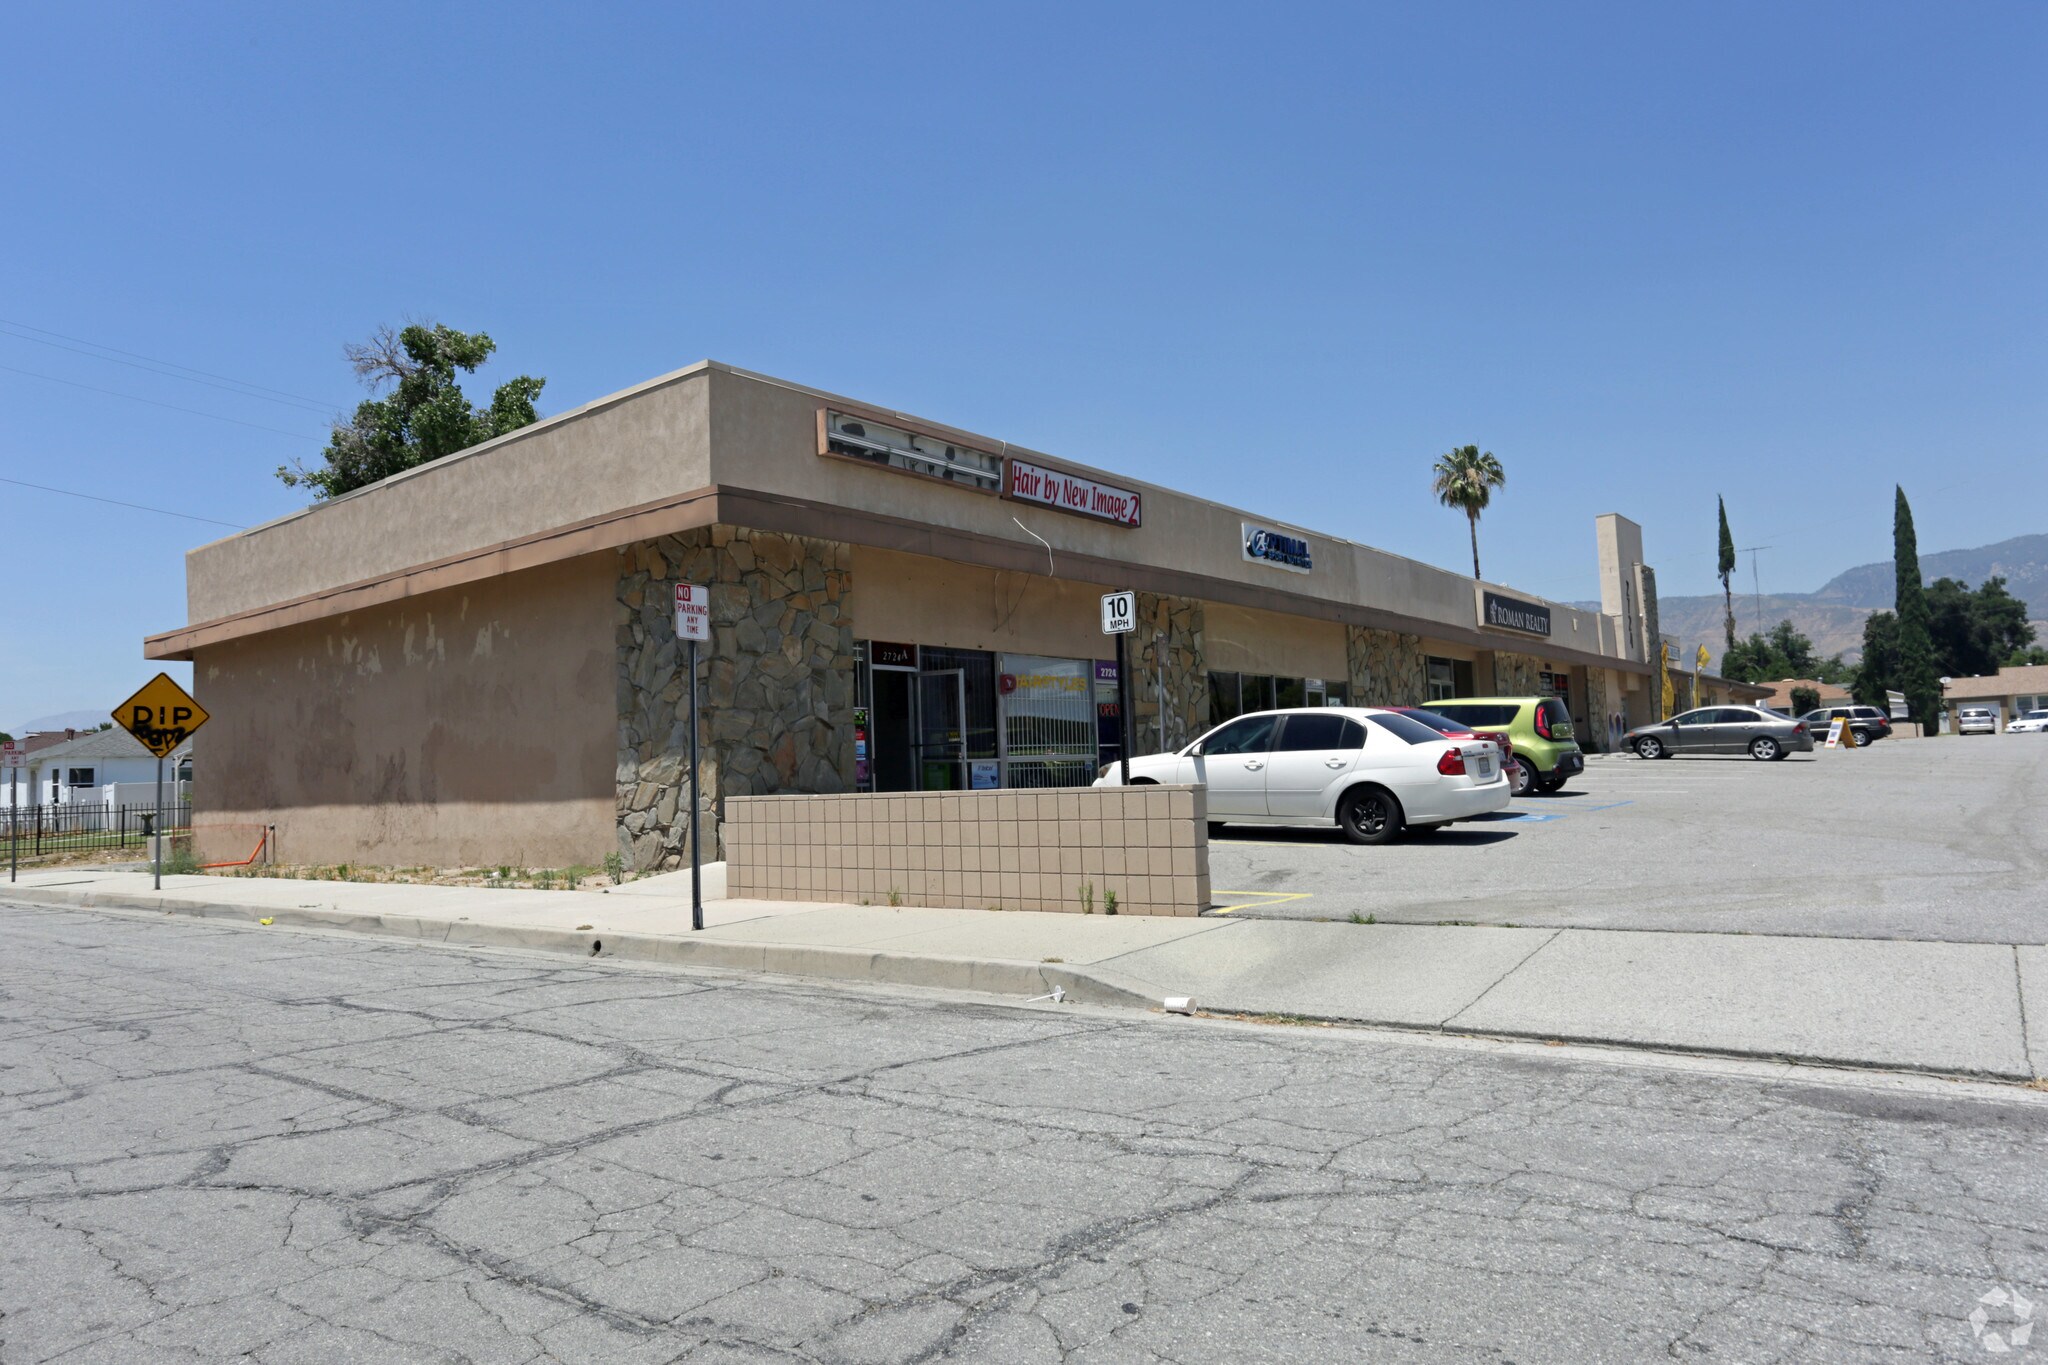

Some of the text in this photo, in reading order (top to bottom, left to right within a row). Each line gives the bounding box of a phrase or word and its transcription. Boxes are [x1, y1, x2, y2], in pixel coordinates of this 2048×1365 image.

[1013, 464, 1139, 525] Hair by New Image 2
[678, 586, 690, 600] NO
[677, 603, 707, 615] PARKING
[1108, 597, 1128, 618] 10
[687, 616, 698, 624] ANY
[1110, 619, 1129, 630] MPH
[1498, 606, 1548, 633] ROMAN REALTY
[686, 625, 699, 634] TIME
[1100, 668, 1117, 678] 2724
[133, 705, 192, 725] DIP
